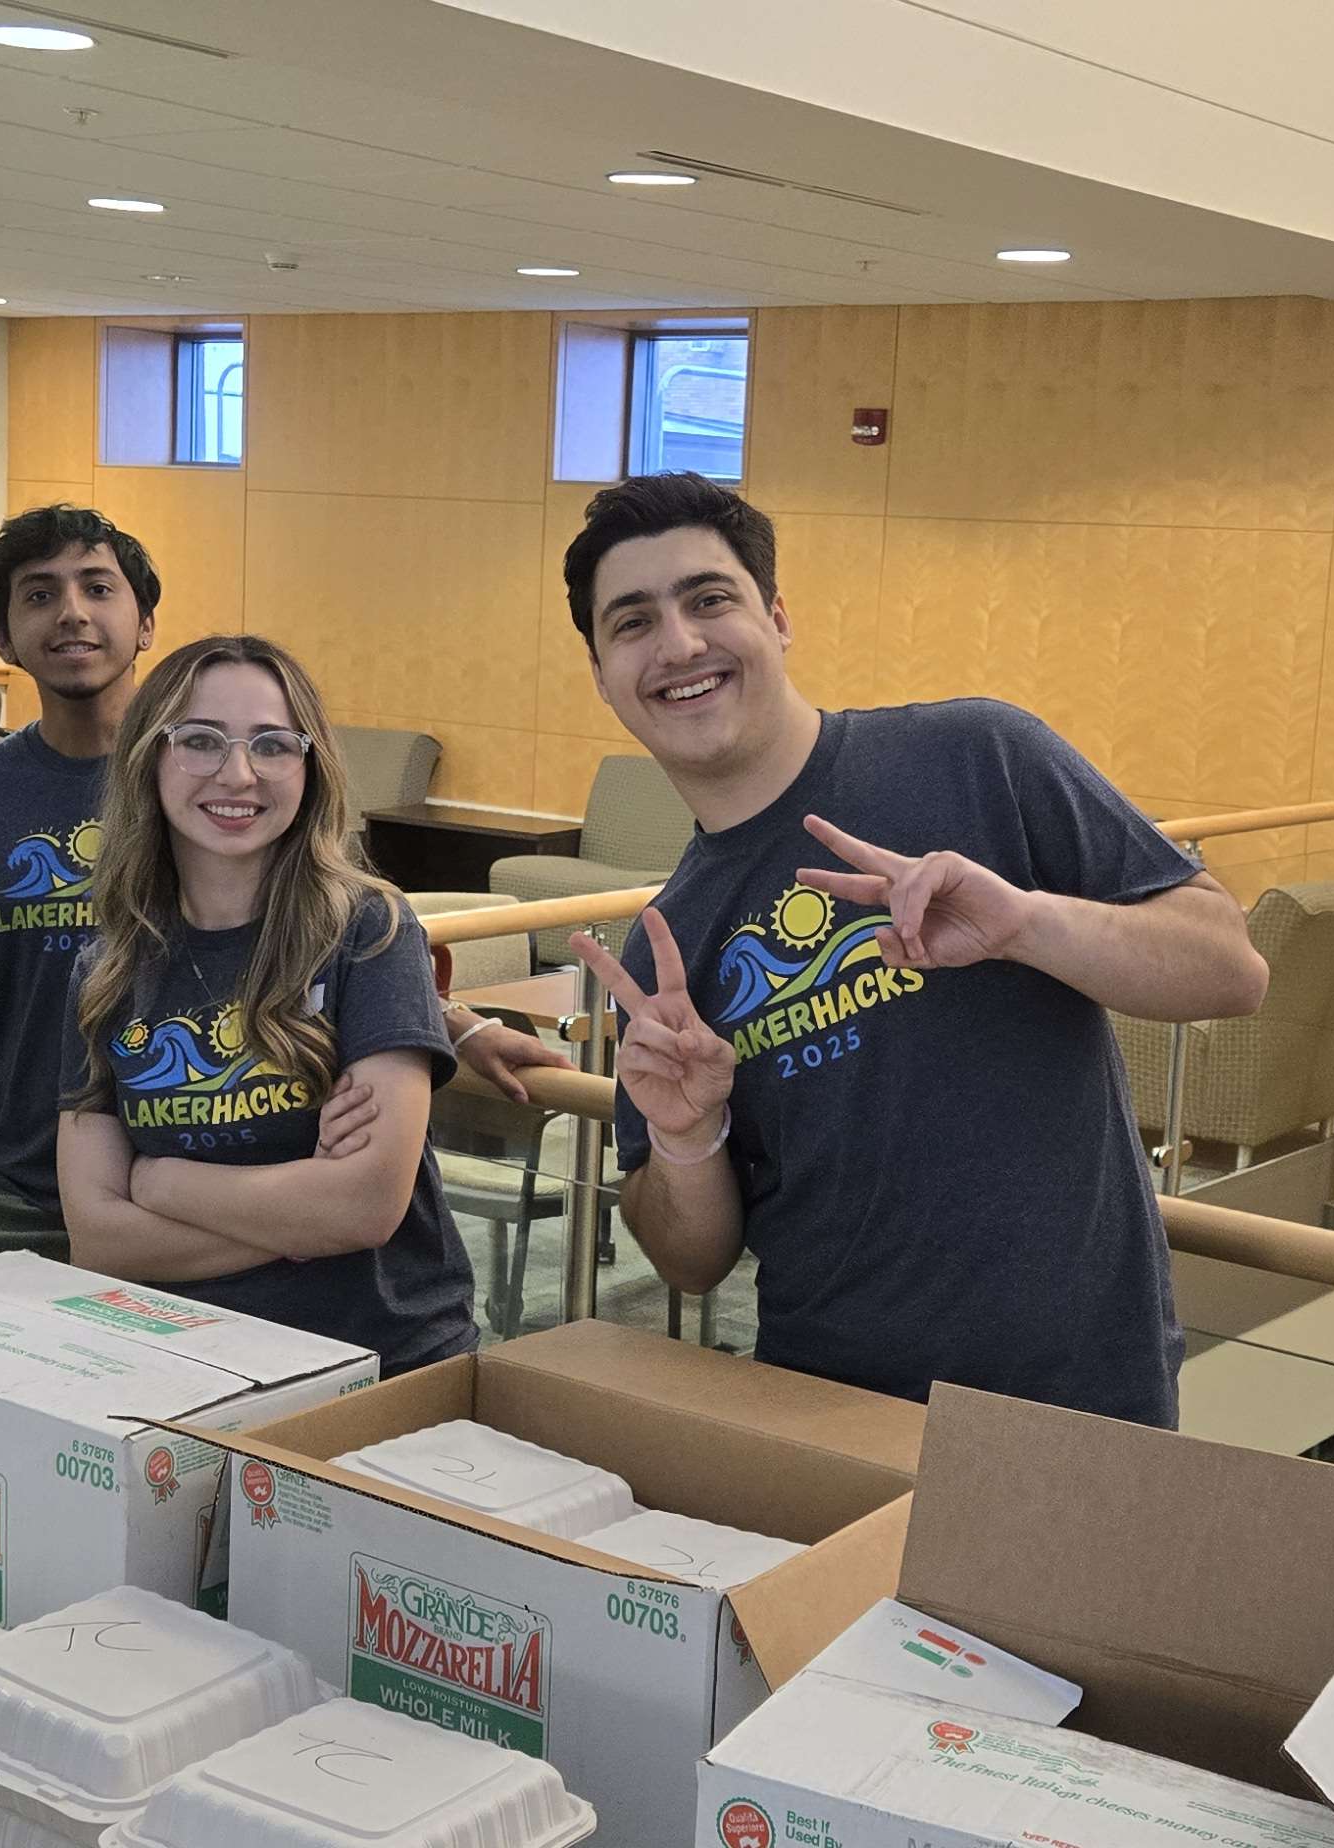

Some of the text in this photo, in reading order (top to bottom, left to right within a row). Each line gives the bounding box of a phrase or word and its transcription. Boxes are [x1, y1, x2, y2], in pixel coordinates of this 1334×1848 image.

[733, 967, 924, 1065] AKERHACKS
[777, 1027, 861, 1079] 2025
[122, 1079, 309, 1128] LAKERHACKS
[178, 1128, 259, 1151] 2025
[72, 1440, 115, 1463] 6 37876
[401, 1581, 496, 1642] GRANDE
[627, 1581, 680, 1609] 6 37876
[356, 1567, 542, 1712] MOZZARELLA
[433, 1624, 463, 1642] BRAND
[380, 1684, 513, 1750] WHOLE MILK
[402, 1678, 489, 1718] LOW-MOISTURE
[931, 1753, 966, 1769] The
[967, 1763, 1018, 1782] finest
[1020, 1775, 1082, 1801] Italian
[1086, 1797, 1152, 1821] cheeses
[1155, 1817, 1218, 1841] money
[785, 1825, 820, 1847] Used
[787, 1810, 831, 1834] Best If
